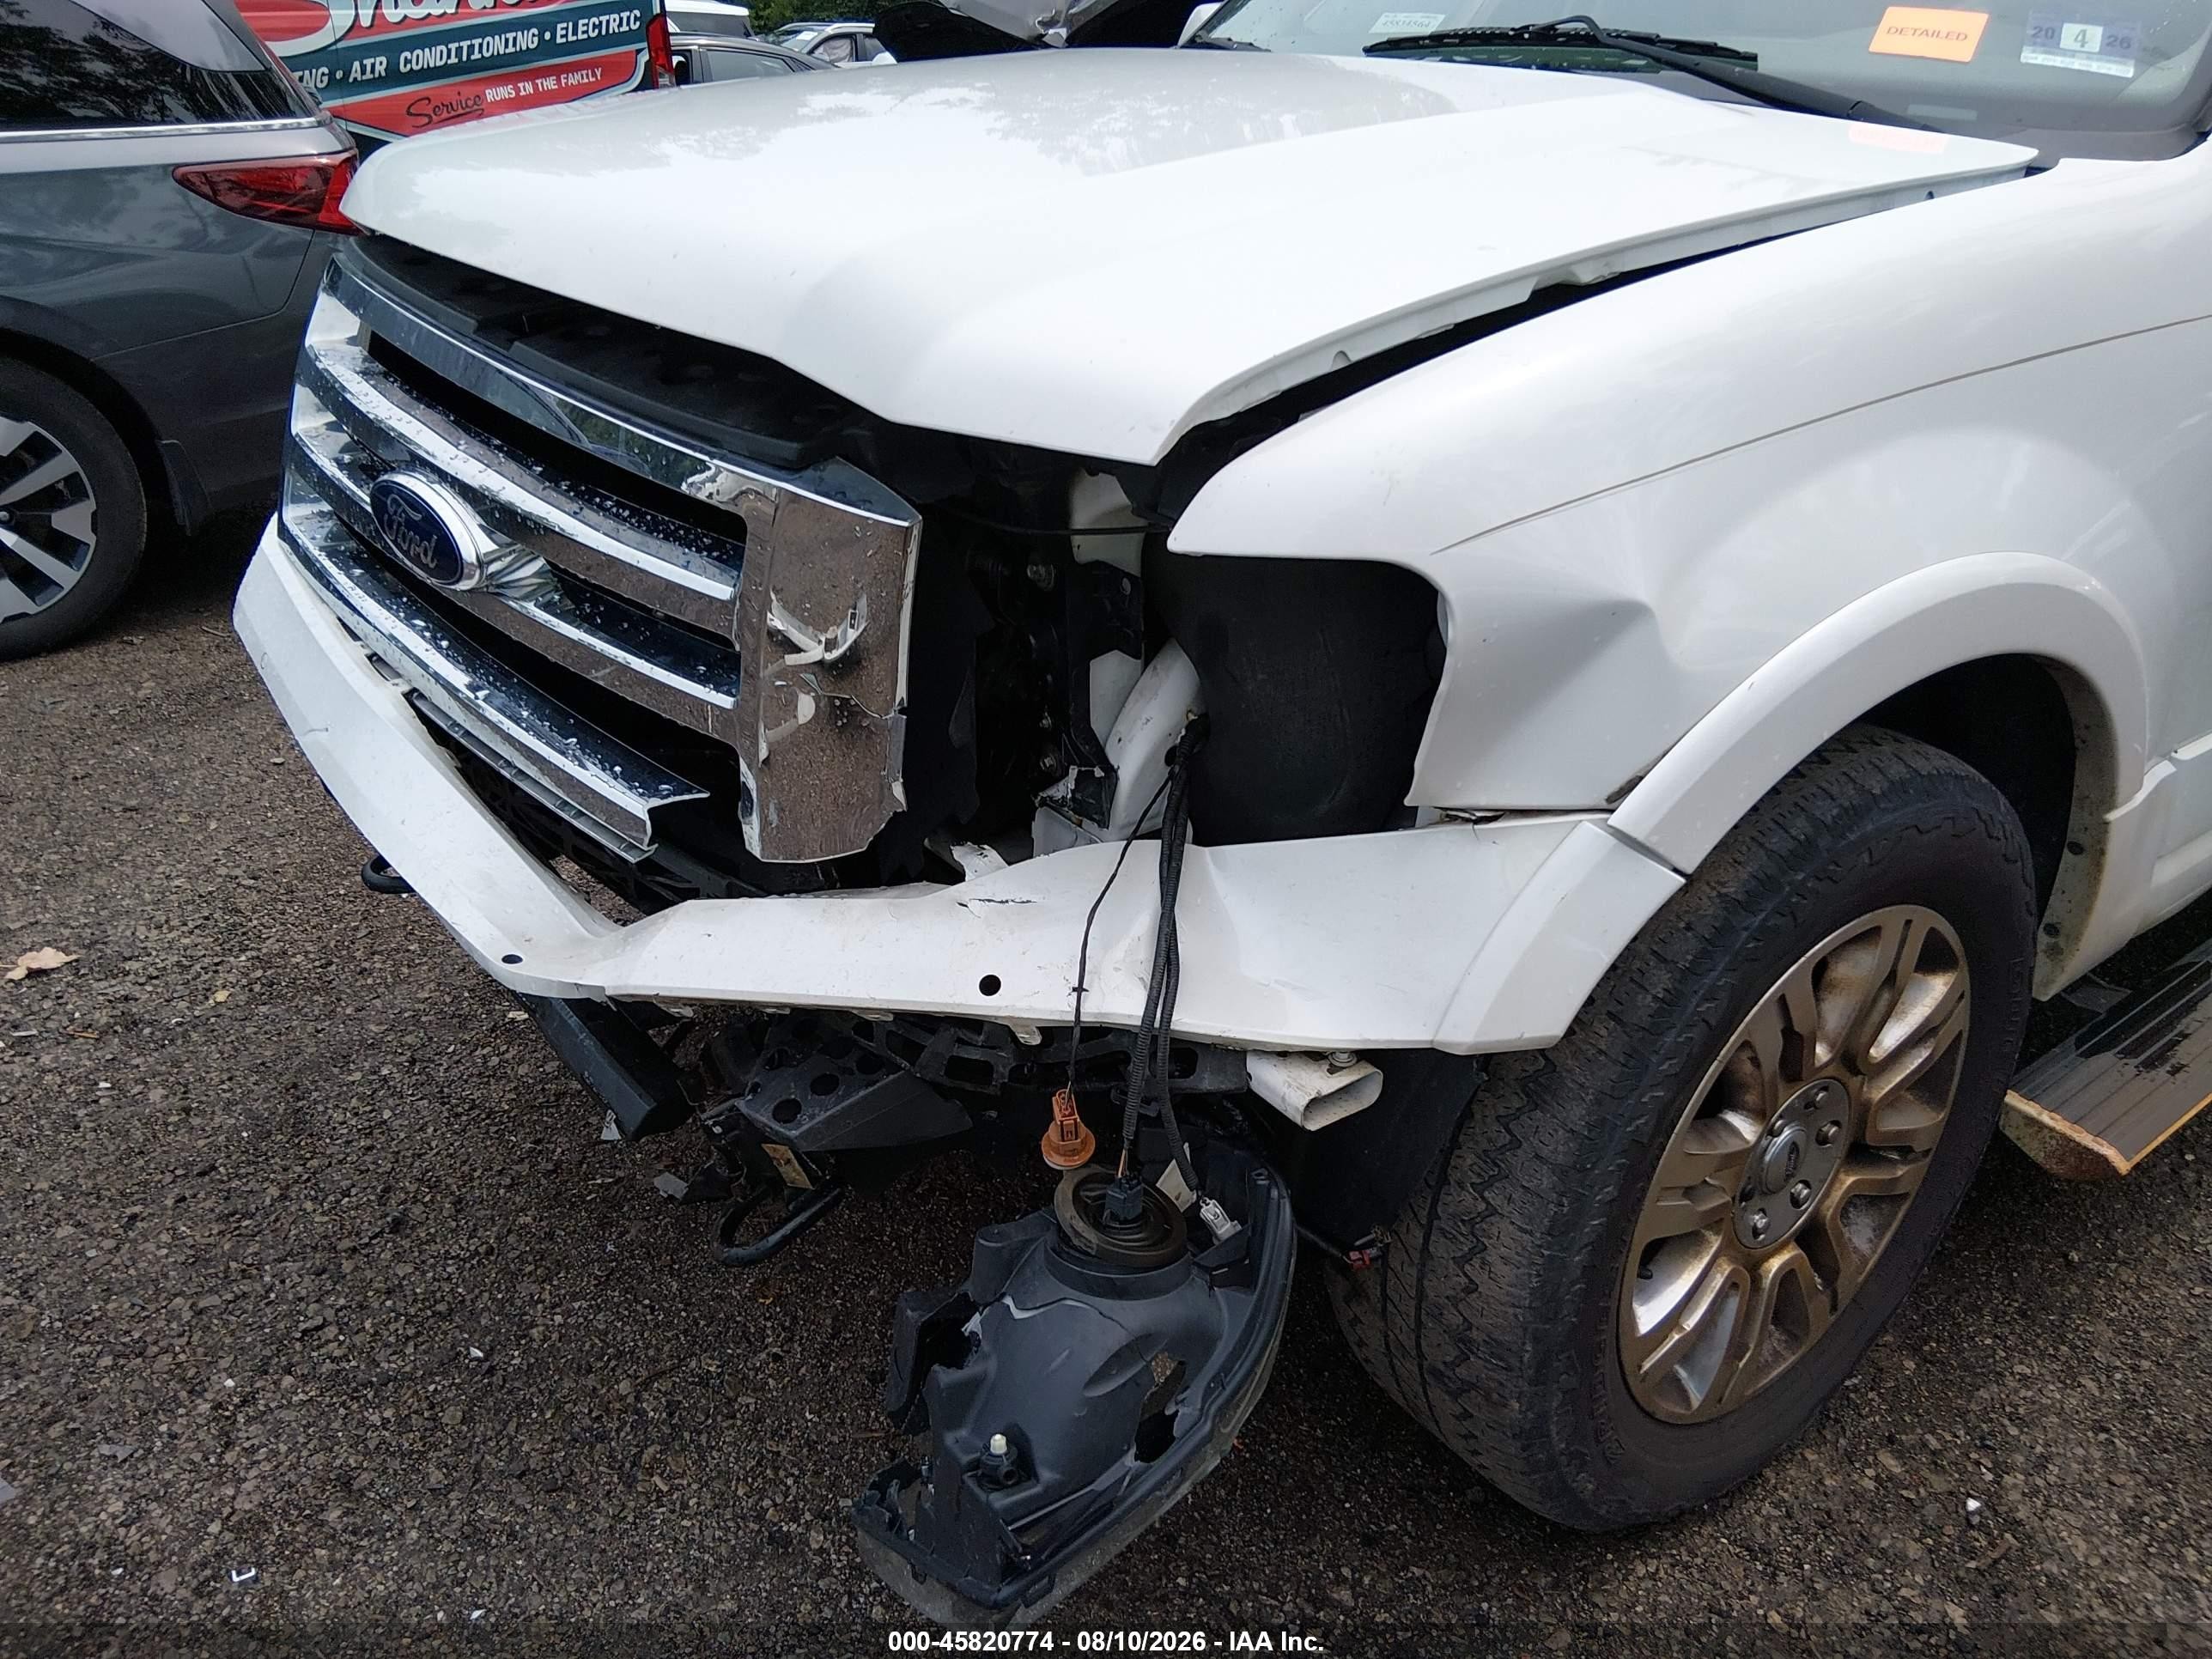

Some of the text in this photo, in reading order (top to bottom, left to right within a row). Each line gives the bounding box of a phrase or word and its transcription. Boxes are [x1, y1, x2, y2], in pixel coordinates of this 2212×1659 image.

[349, 56, 387, 83] AIR
[399, 27, 539, 74] CONDITIONING
[556, 9, 641, 44] ELECTRIC
[1887, 27, 1968, 41] DETAILED
[2032, 26, 2132, 49] 20 4 26
[405, 68, 602, 128] Service RUNS IN THE FAMILY
[384, 494, 438, 568] Ford
